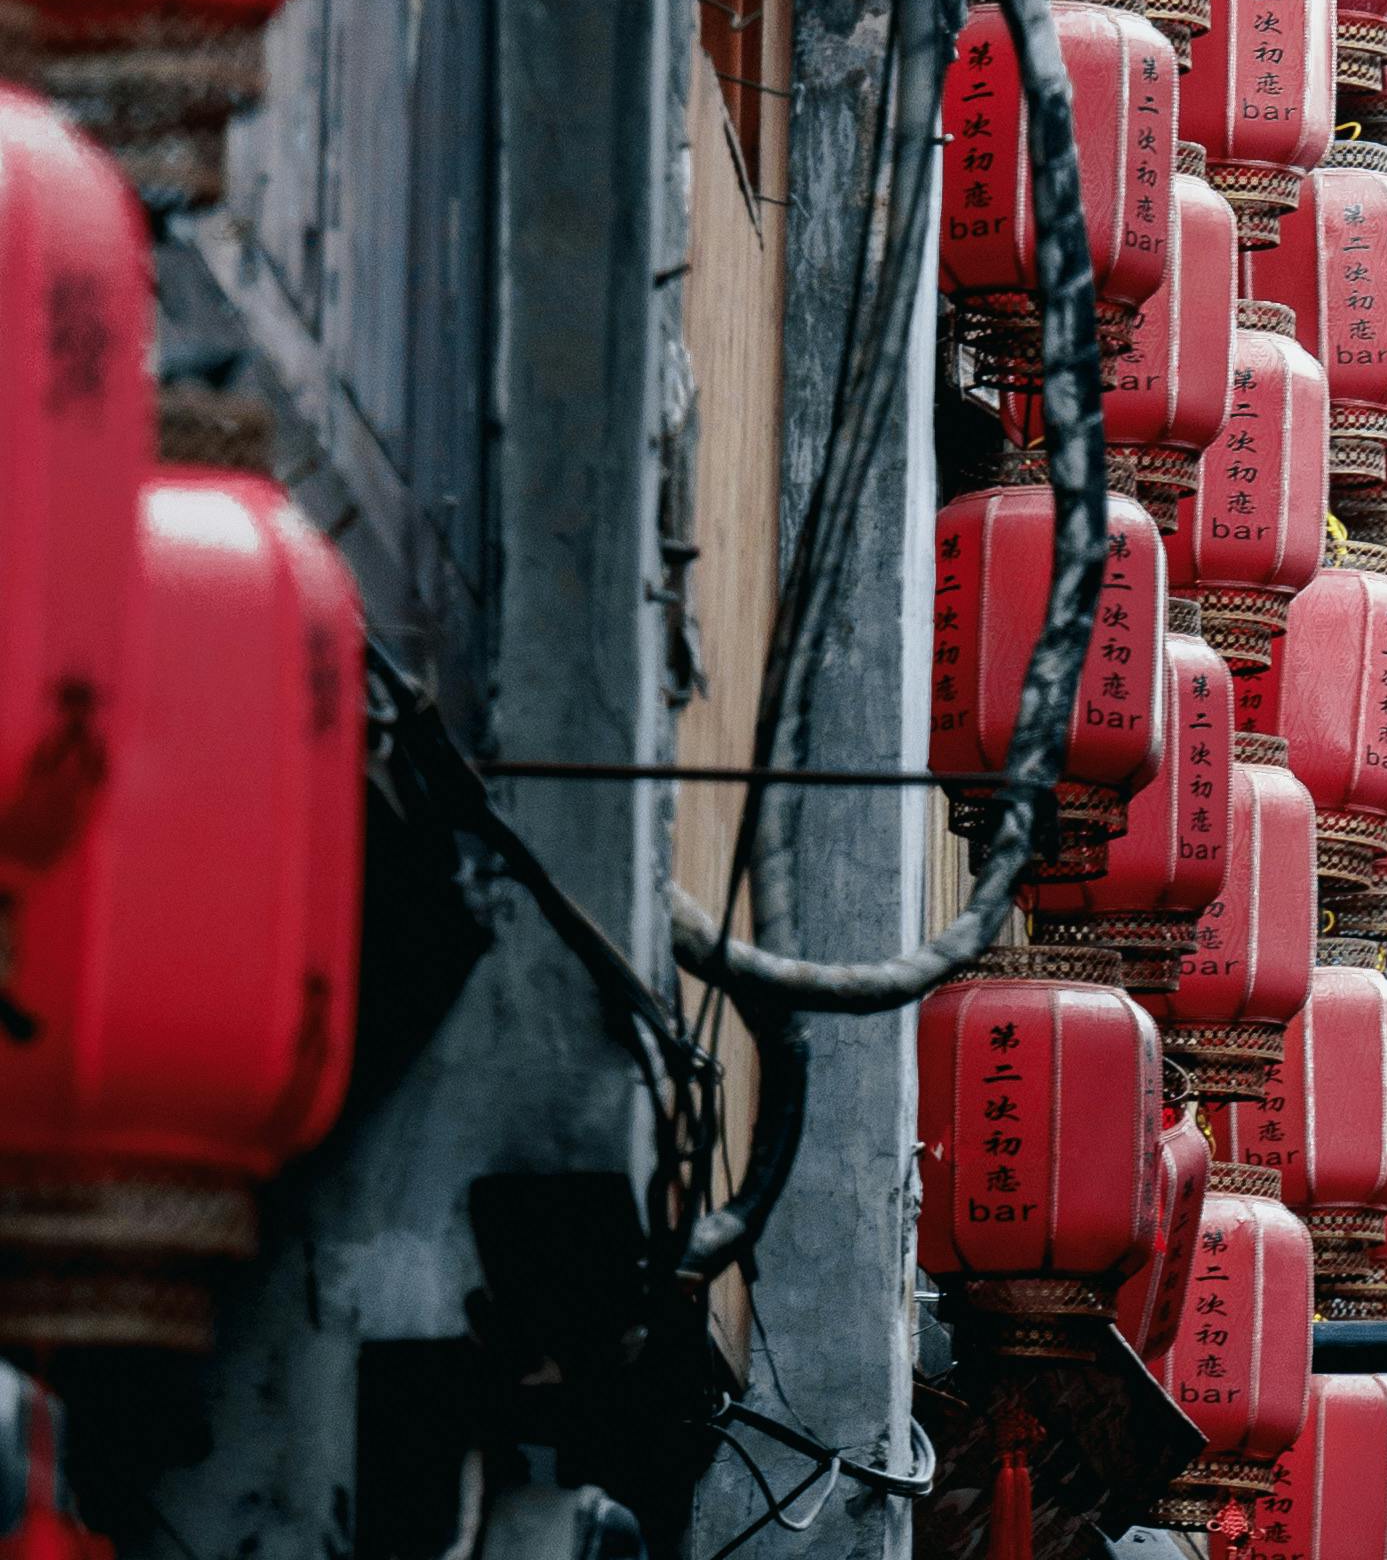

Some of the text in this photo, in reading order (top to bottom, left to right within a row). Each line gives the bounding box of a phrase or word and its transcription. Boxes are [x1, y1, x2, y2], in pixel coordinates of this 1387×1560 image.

[950, 43, 1008, 239] 第二次初恋 bar
[1126, 58, 1166, 252] 第二次初恋 bar
[1243, 98, 1297, 122] bar
[1344, 206, 1374, 340] 第二次初恋
[1212, 370, 1271, 541] 第二次初恋 bar
[934, 536, 960, 699] 第二次初恋
[1086, 534, 1142, 730] 第二次初恋 bar
[1180, 676, 1221, 860] 第二次初恋 bar
[969, 1024, 1036, 1224] 第二次初恋 bar
[1246, 1146, 1299, 1167] bar
[1180, 1231, 1240, 1405] 第二次初恋 bar
